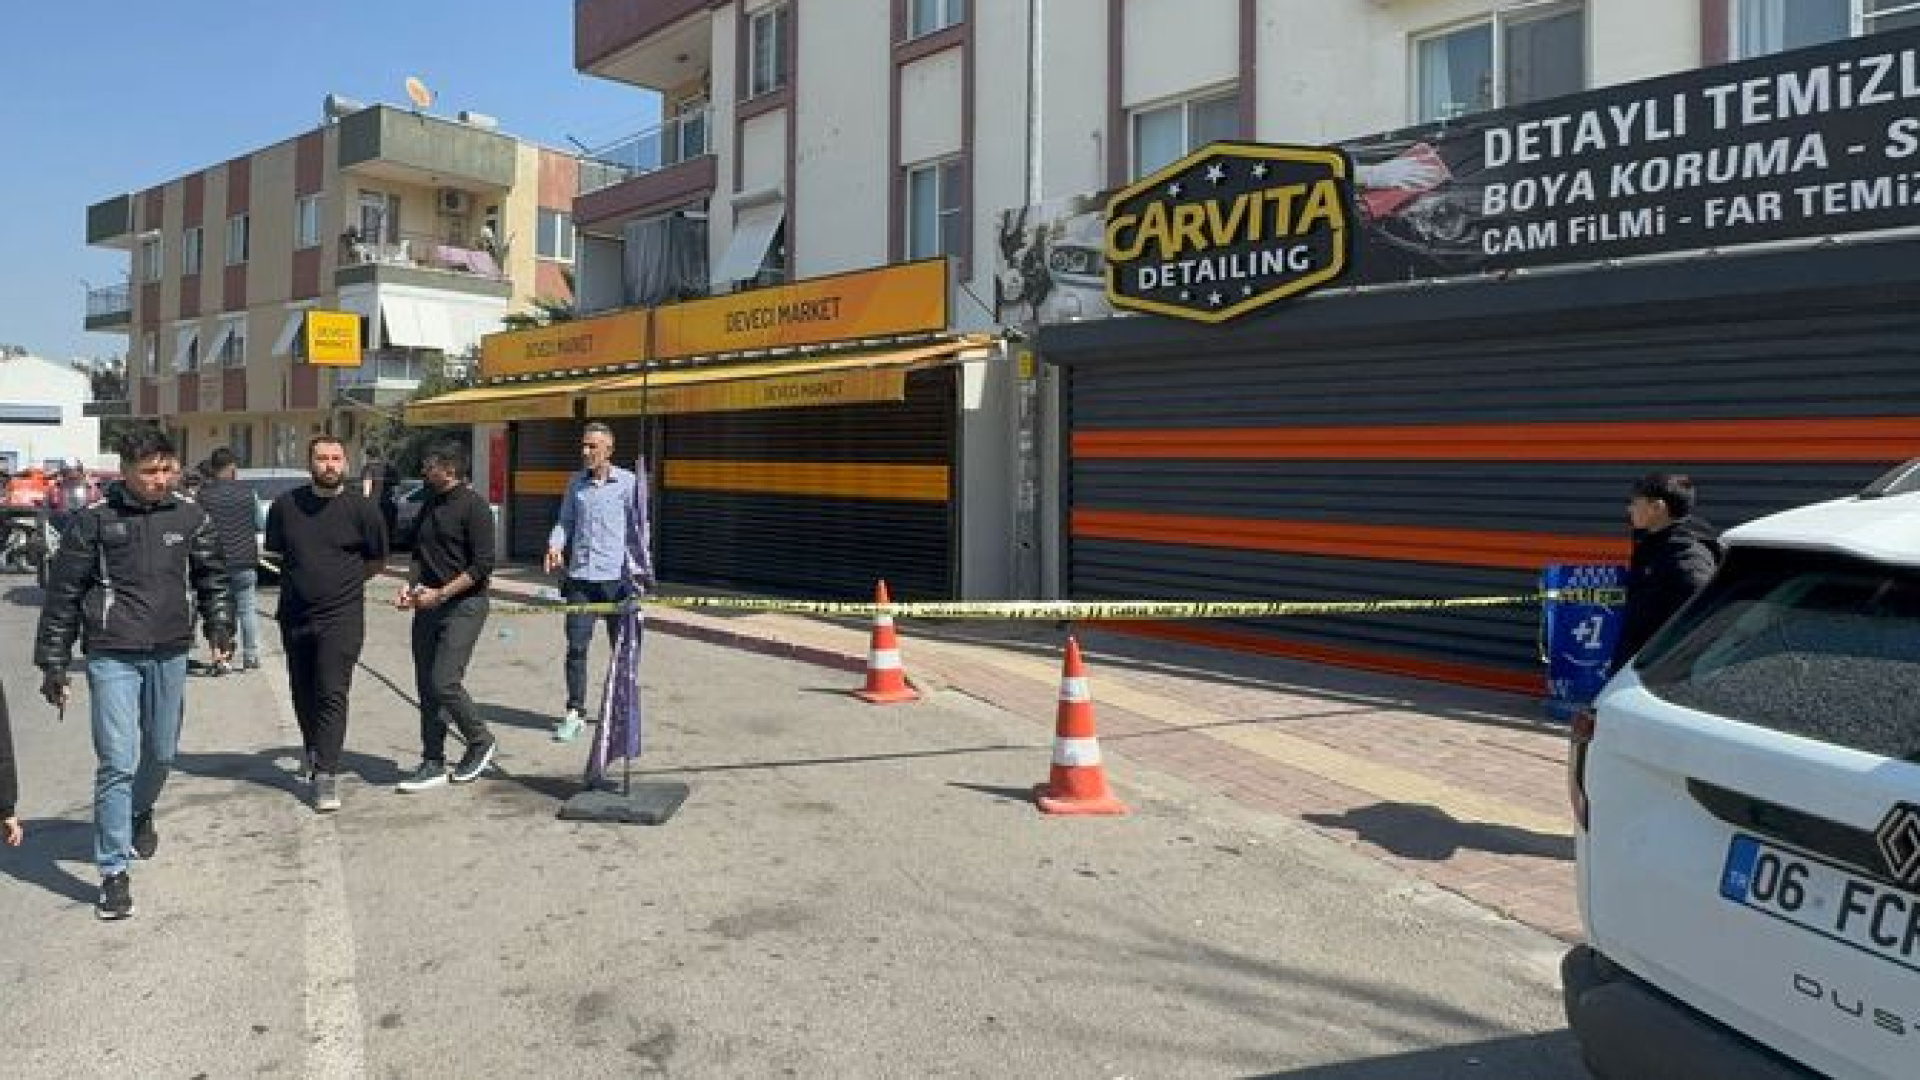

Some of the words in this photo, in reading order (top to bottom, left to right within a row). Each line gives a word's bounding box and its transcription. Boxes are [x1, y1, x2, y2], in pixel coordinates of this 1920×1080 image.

[1484, 93, 1687, 169] DETAYLI
[1482, 168, 1596, 216] BOYA
[1609, 132, 1829, 199] KORUMA
[1106, 179, 1342, 261] CARVITA
[1482, 224, 1558, 255] CAM
[1704, 190, 1783, 229] FAR
[1138, 245, 1309, 290] DETAILING
[777, 297, 842, 325] MARKET
[1752, 854, 1809, 911] 06
[1793, 973, 1920, 1033] DUS
